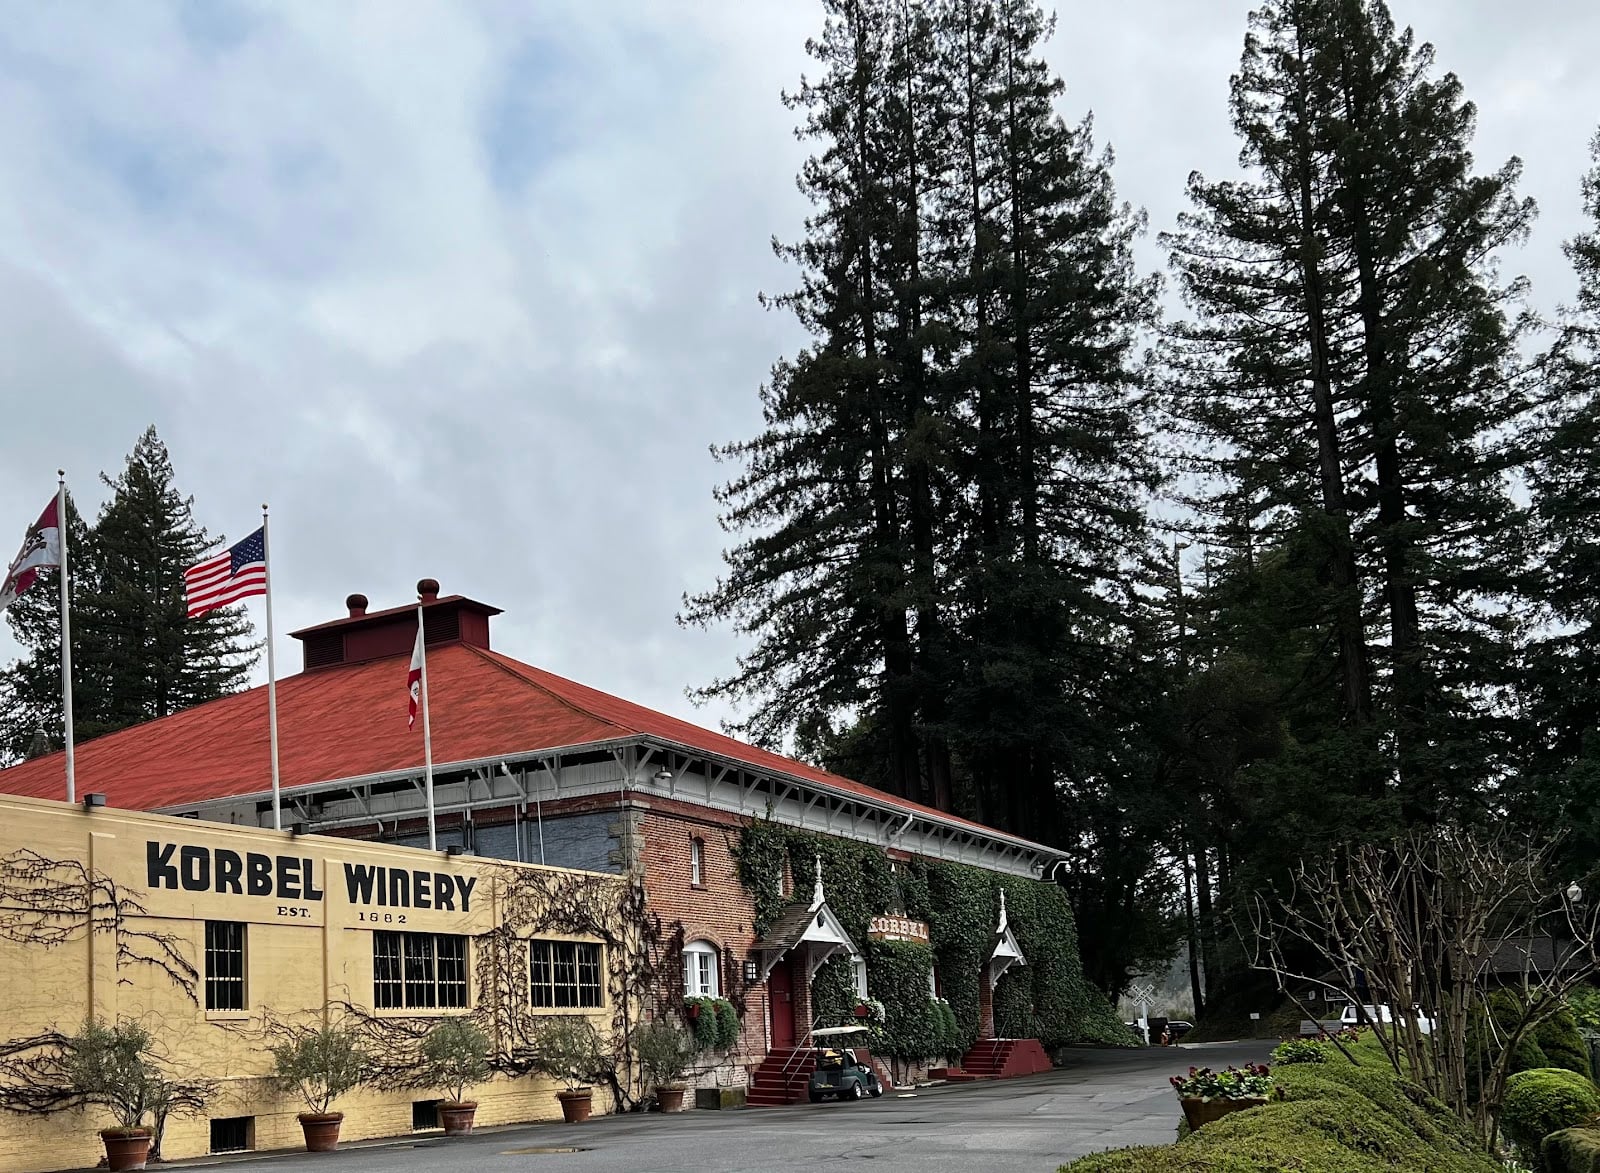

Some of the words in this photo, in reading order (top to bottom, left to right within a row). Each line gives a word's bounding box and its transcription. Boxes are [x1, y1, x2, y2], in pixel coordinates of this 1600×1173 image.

[146, 840, 324, 901] KORBEL
[343, 862, 477, 912] WINERY
[277, 906, 311, 918] EST.
[359, 912, 407, 924] 1882
